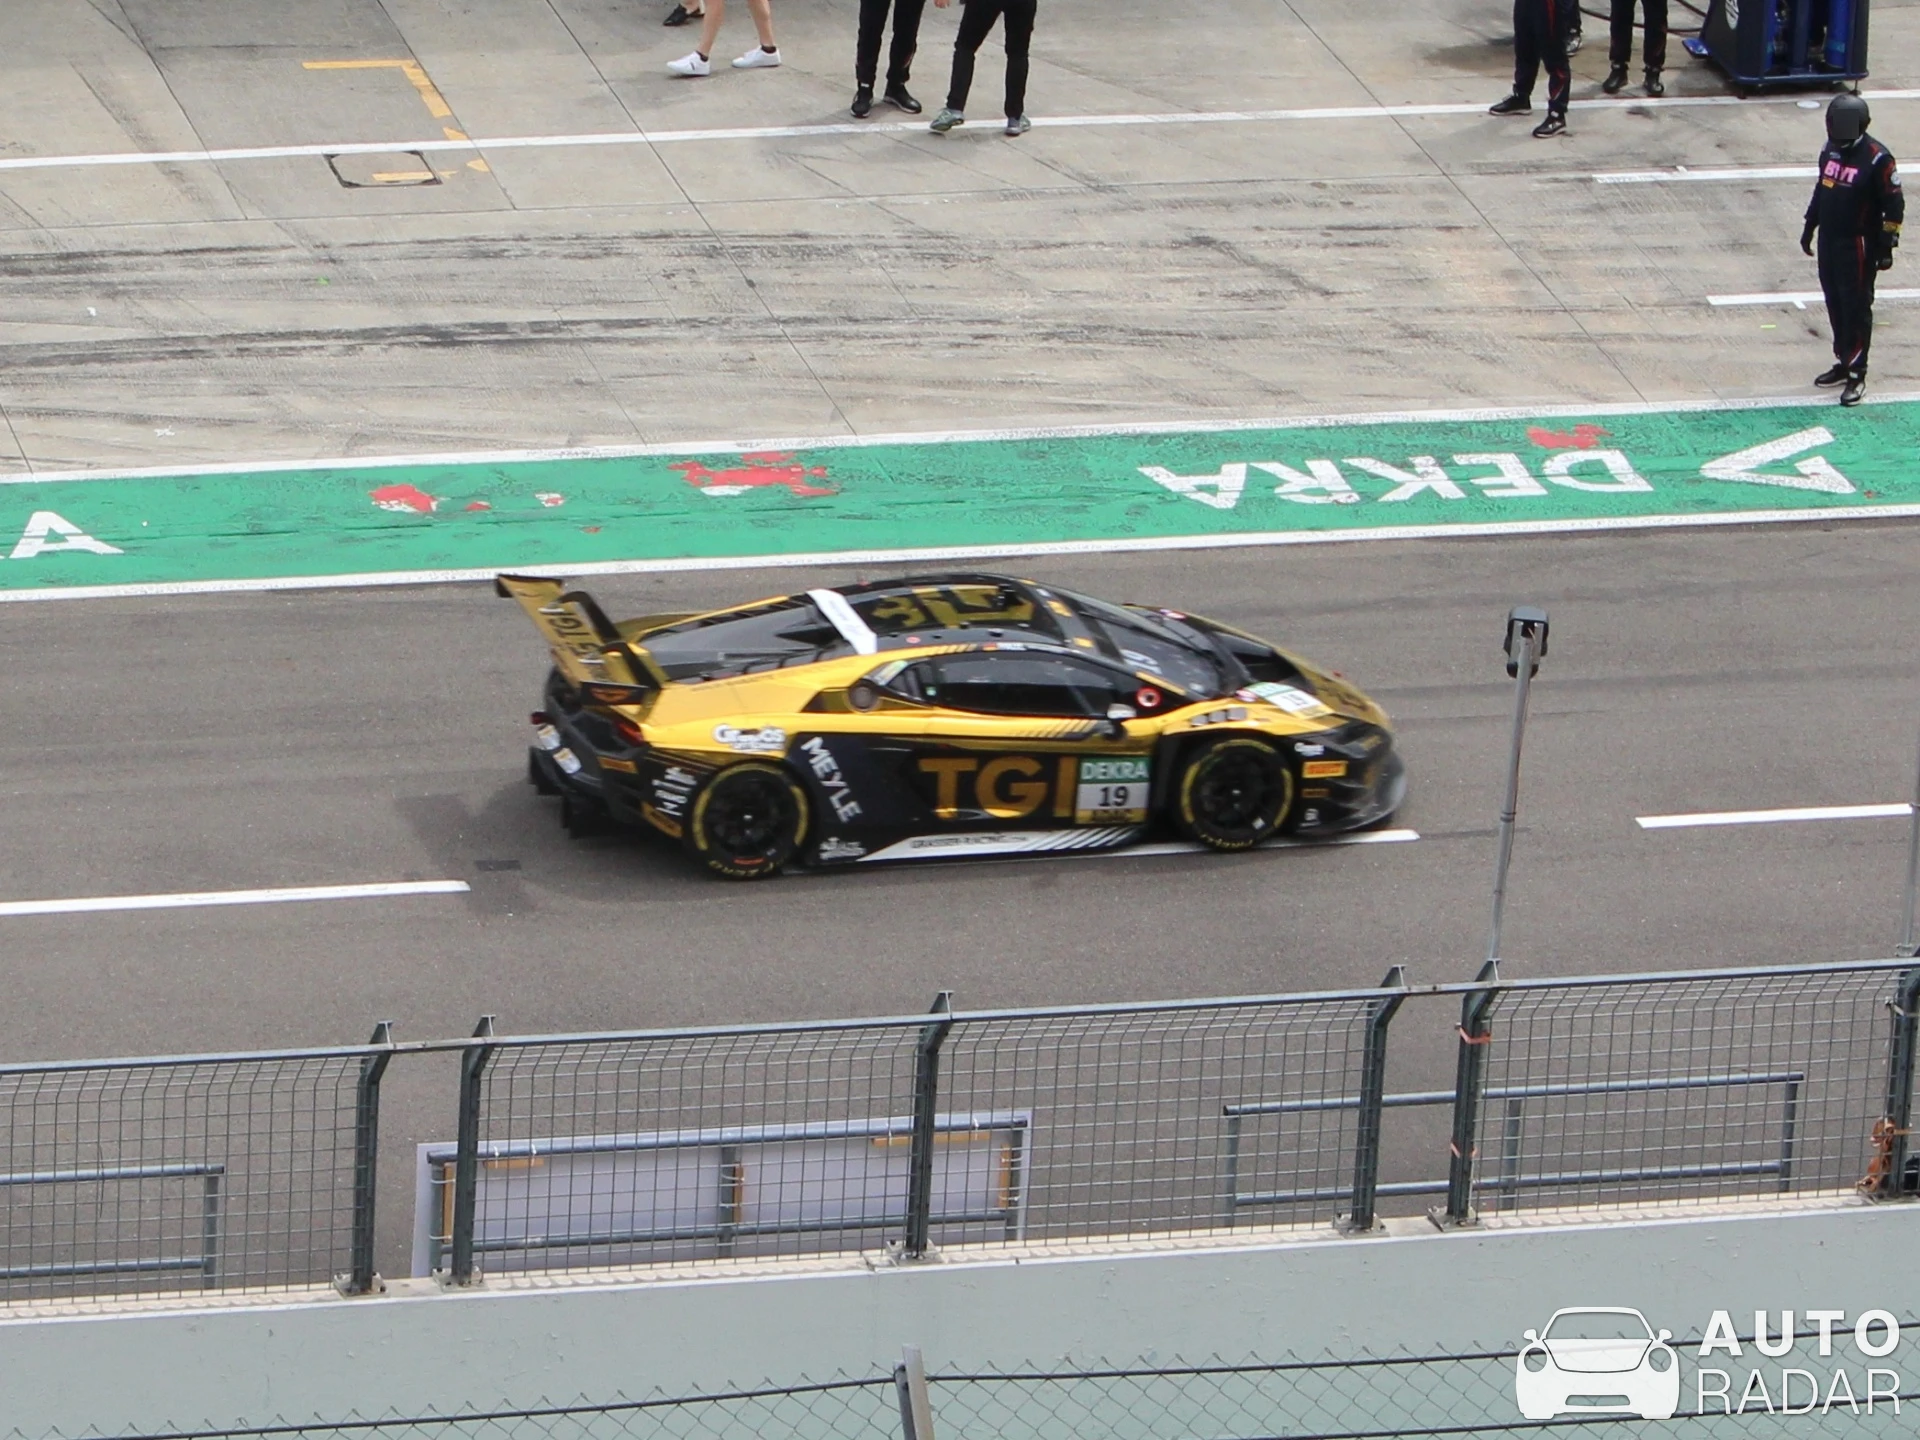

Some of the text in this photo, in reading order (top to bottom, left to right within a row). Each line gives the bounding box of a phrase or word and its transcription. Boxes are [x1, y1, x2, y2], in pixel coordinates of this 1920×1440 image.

[1137, 449, 1654, 509] DEKRA
[0, 511, 125, 559] A
[800, 736, 863, 824] MEYLE
[917, 755, 1078, 819] TGI
[1081, 761, 1150, 780] DEKRA
[1098, 785, 1130, 807] 19
